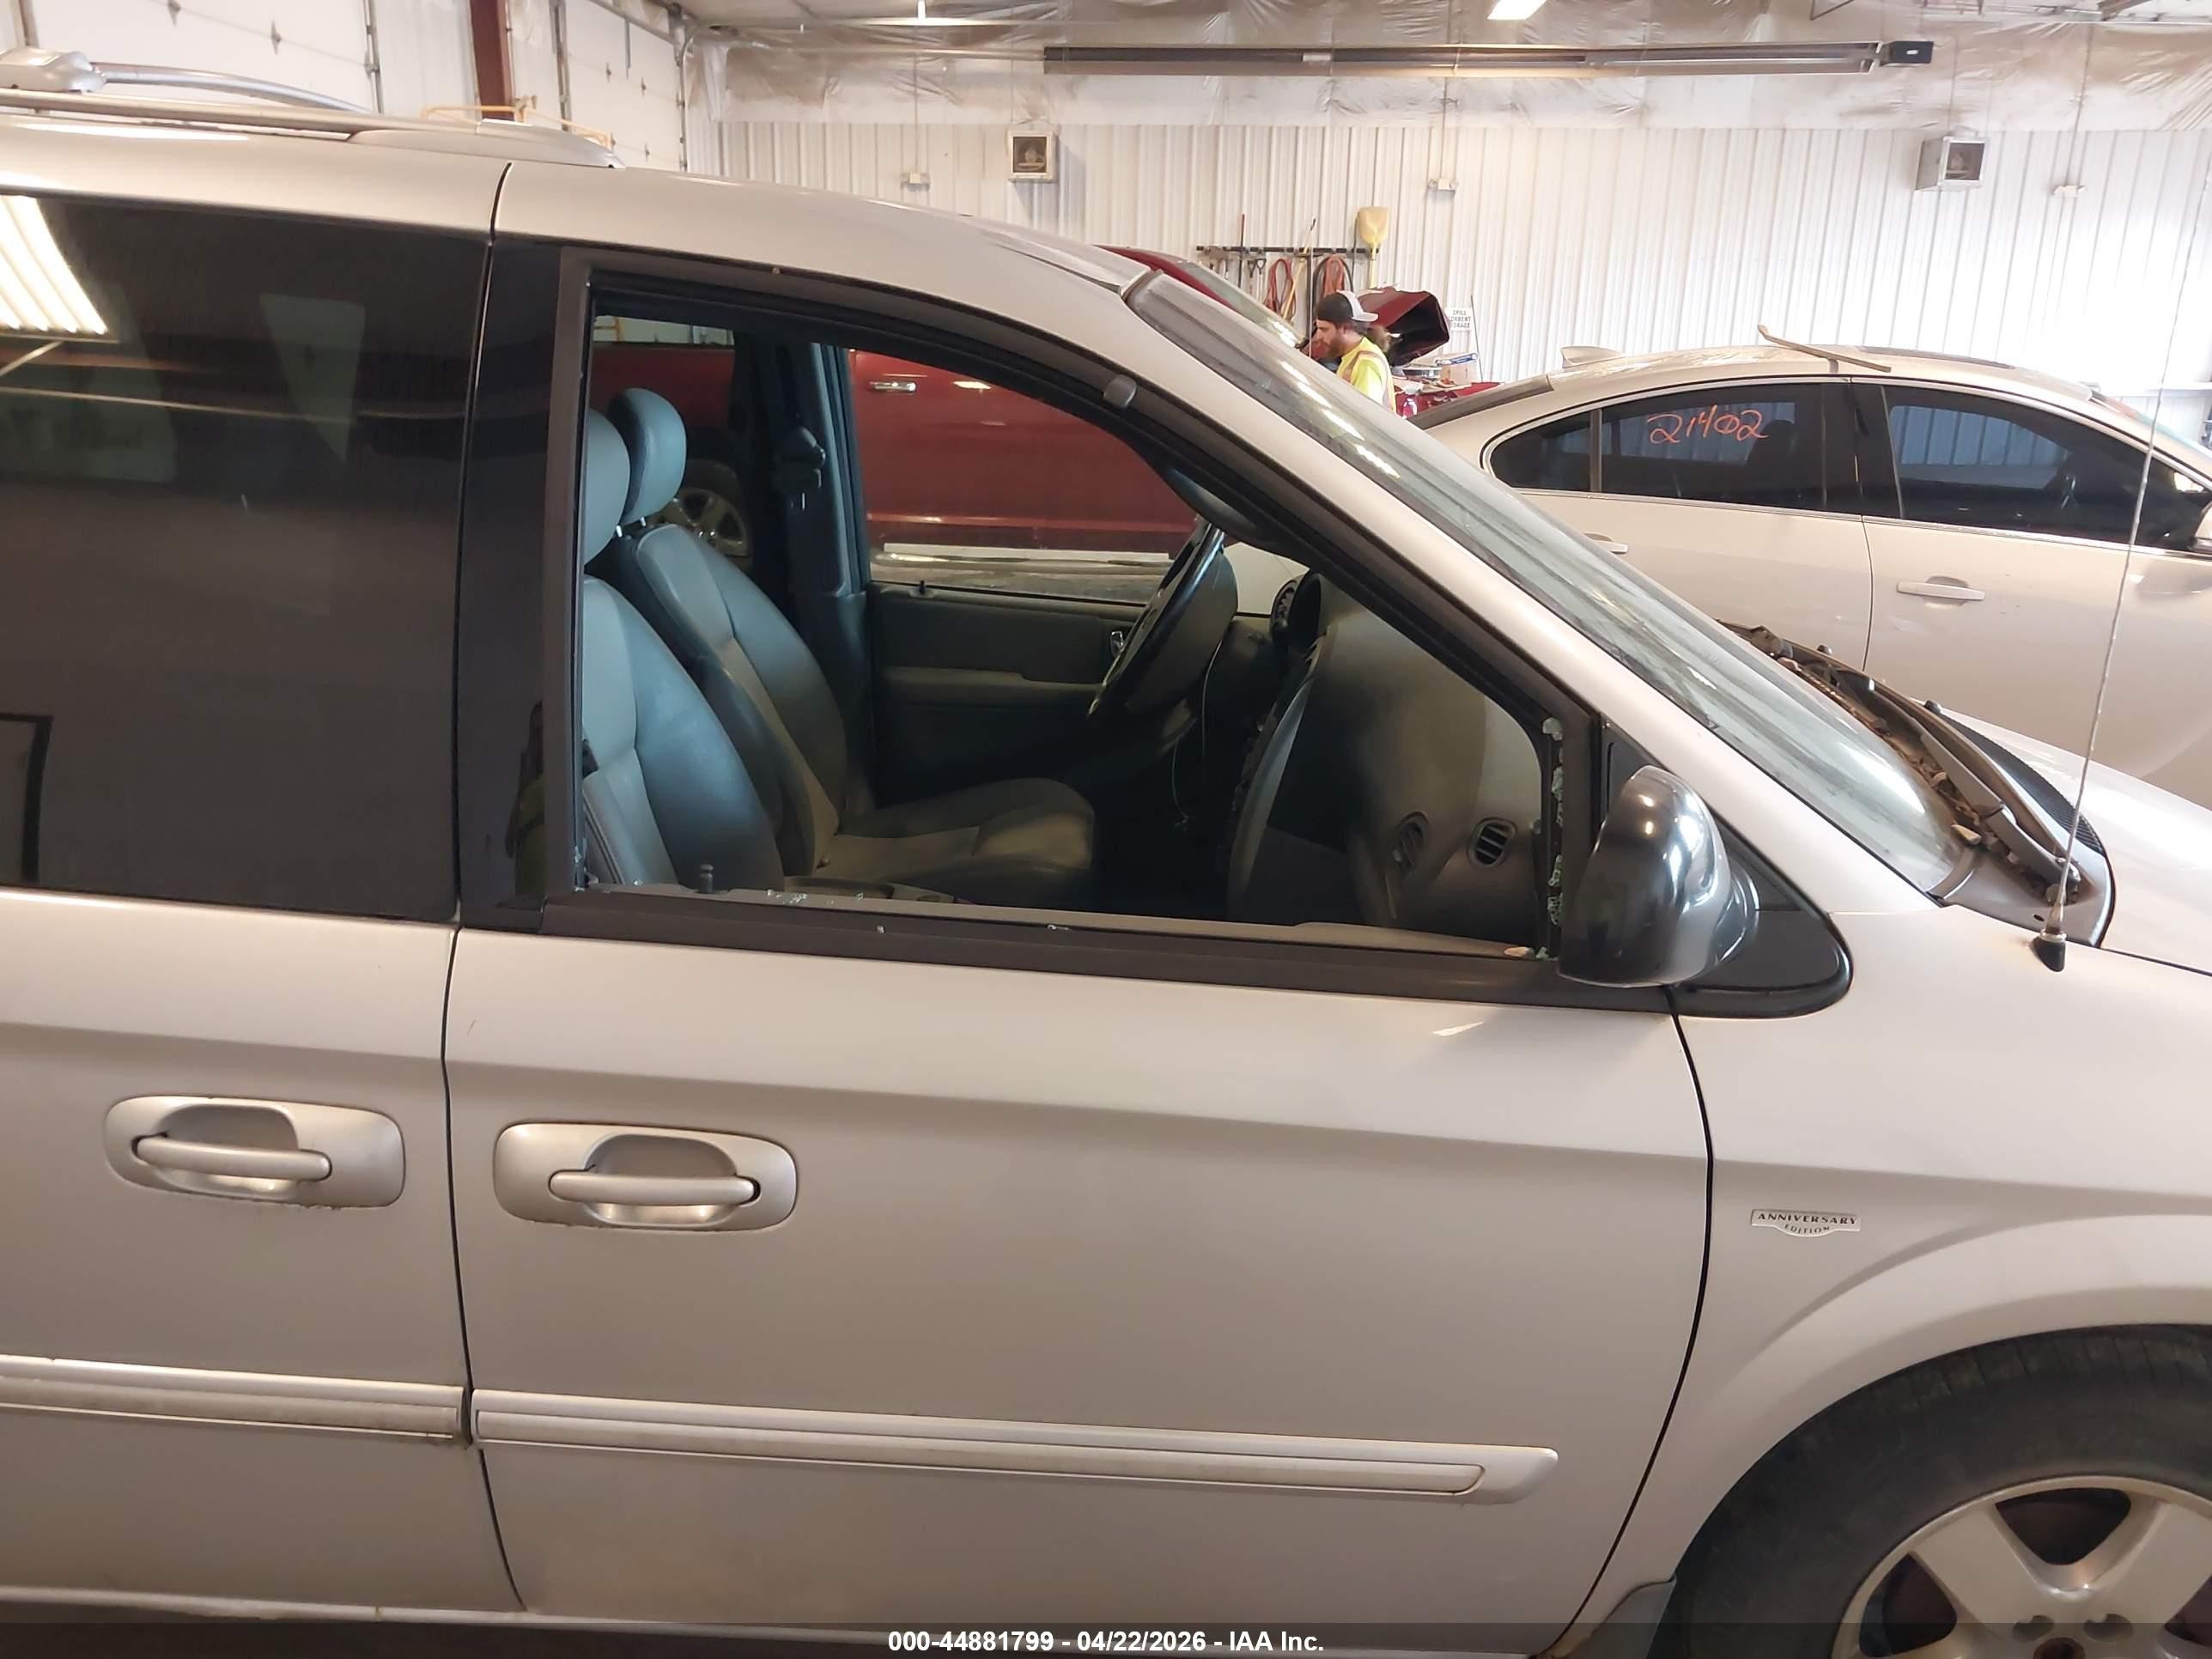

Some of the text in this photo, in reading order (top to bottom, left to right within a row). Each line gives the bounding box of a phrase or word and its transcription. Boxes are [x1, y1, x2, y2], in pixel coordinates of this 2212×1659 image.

[1647, 404, 1769, 444] 21402
[1757, 1212, 1858, 1225] ANNIVERSARY
[1784, 1224, 1831, 1235] EDITION
